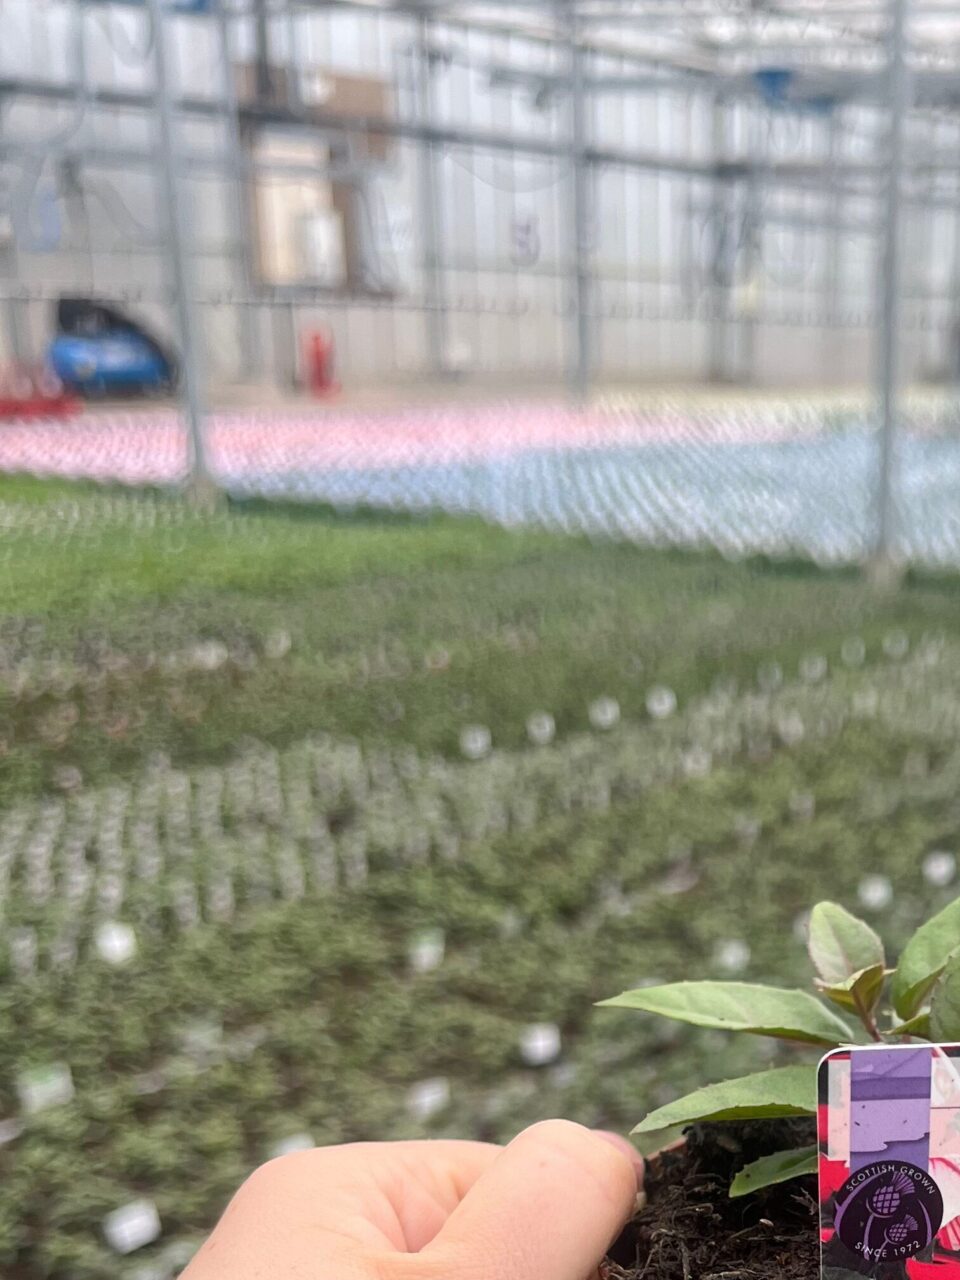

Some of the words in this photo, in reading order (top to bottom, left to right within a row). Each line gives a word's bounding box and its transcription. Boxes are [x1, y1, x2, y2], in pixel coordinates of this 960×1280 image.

[846, 1164, 895, 1191] SCOTTISH
[900, 1166, 936, 1195] GROWN
[854, 1241, 887, 1258] SINCE
[894, 1240, 921, 1256] 1972
